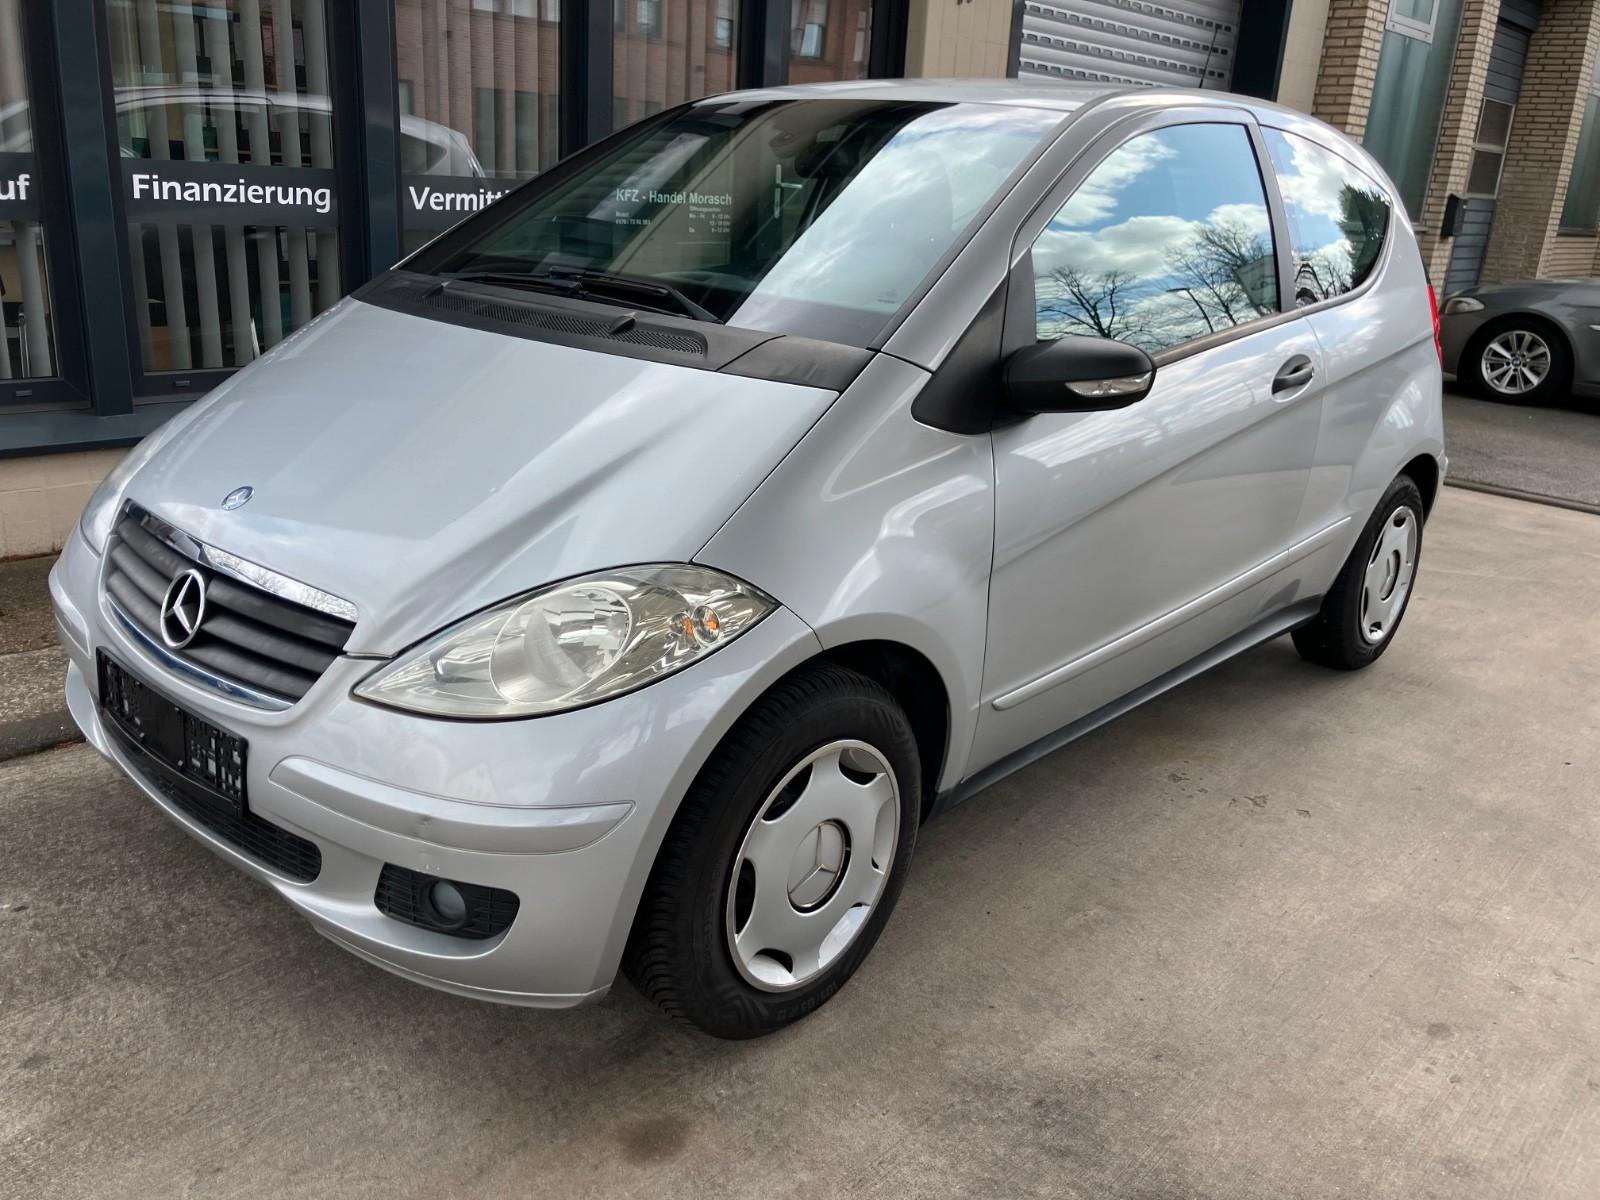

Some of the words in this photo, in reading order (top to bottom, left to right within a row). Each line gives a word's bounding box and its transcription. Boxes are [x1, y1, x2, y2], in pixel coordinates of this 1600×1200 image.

[132, 174, 331, 214] Finanzierung
[408, 186, 510, 211] Vermit
[616, 188, 640, 202] KFZ
[649, 190, 686, 204] Handel
[689, 192, 732, 205] Morasch
